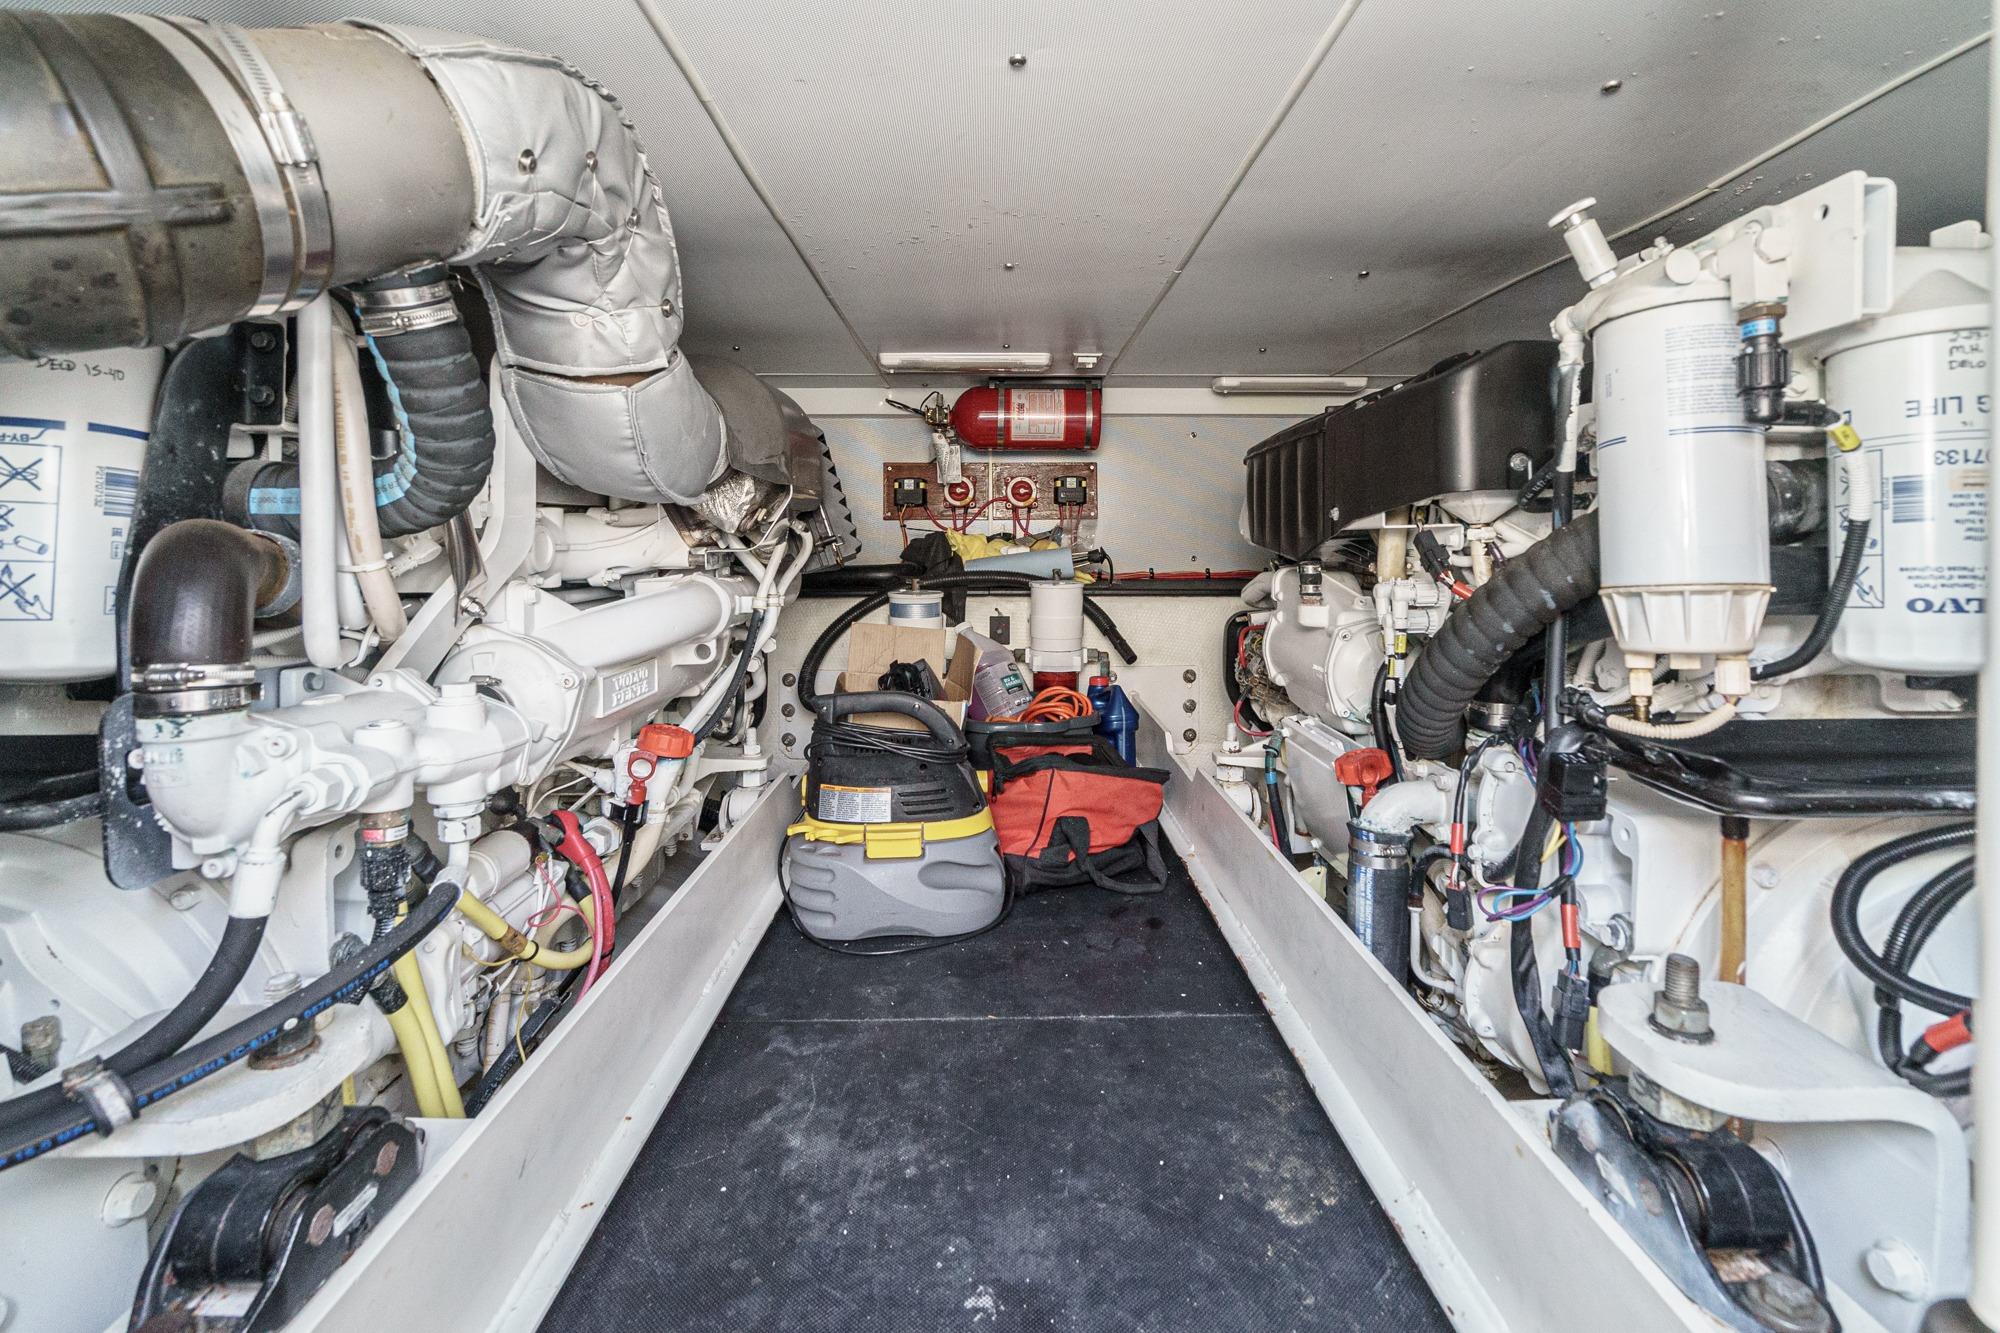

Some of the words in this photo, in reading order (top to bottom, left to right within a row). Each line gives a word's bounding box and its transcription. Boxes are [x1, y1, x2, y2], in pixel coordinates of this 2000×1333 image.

[1905, 395, 1963, 418] LIFE
[1906, 598, 1987, 613] LVO
[612, 667, 649, 691] VOLVO
